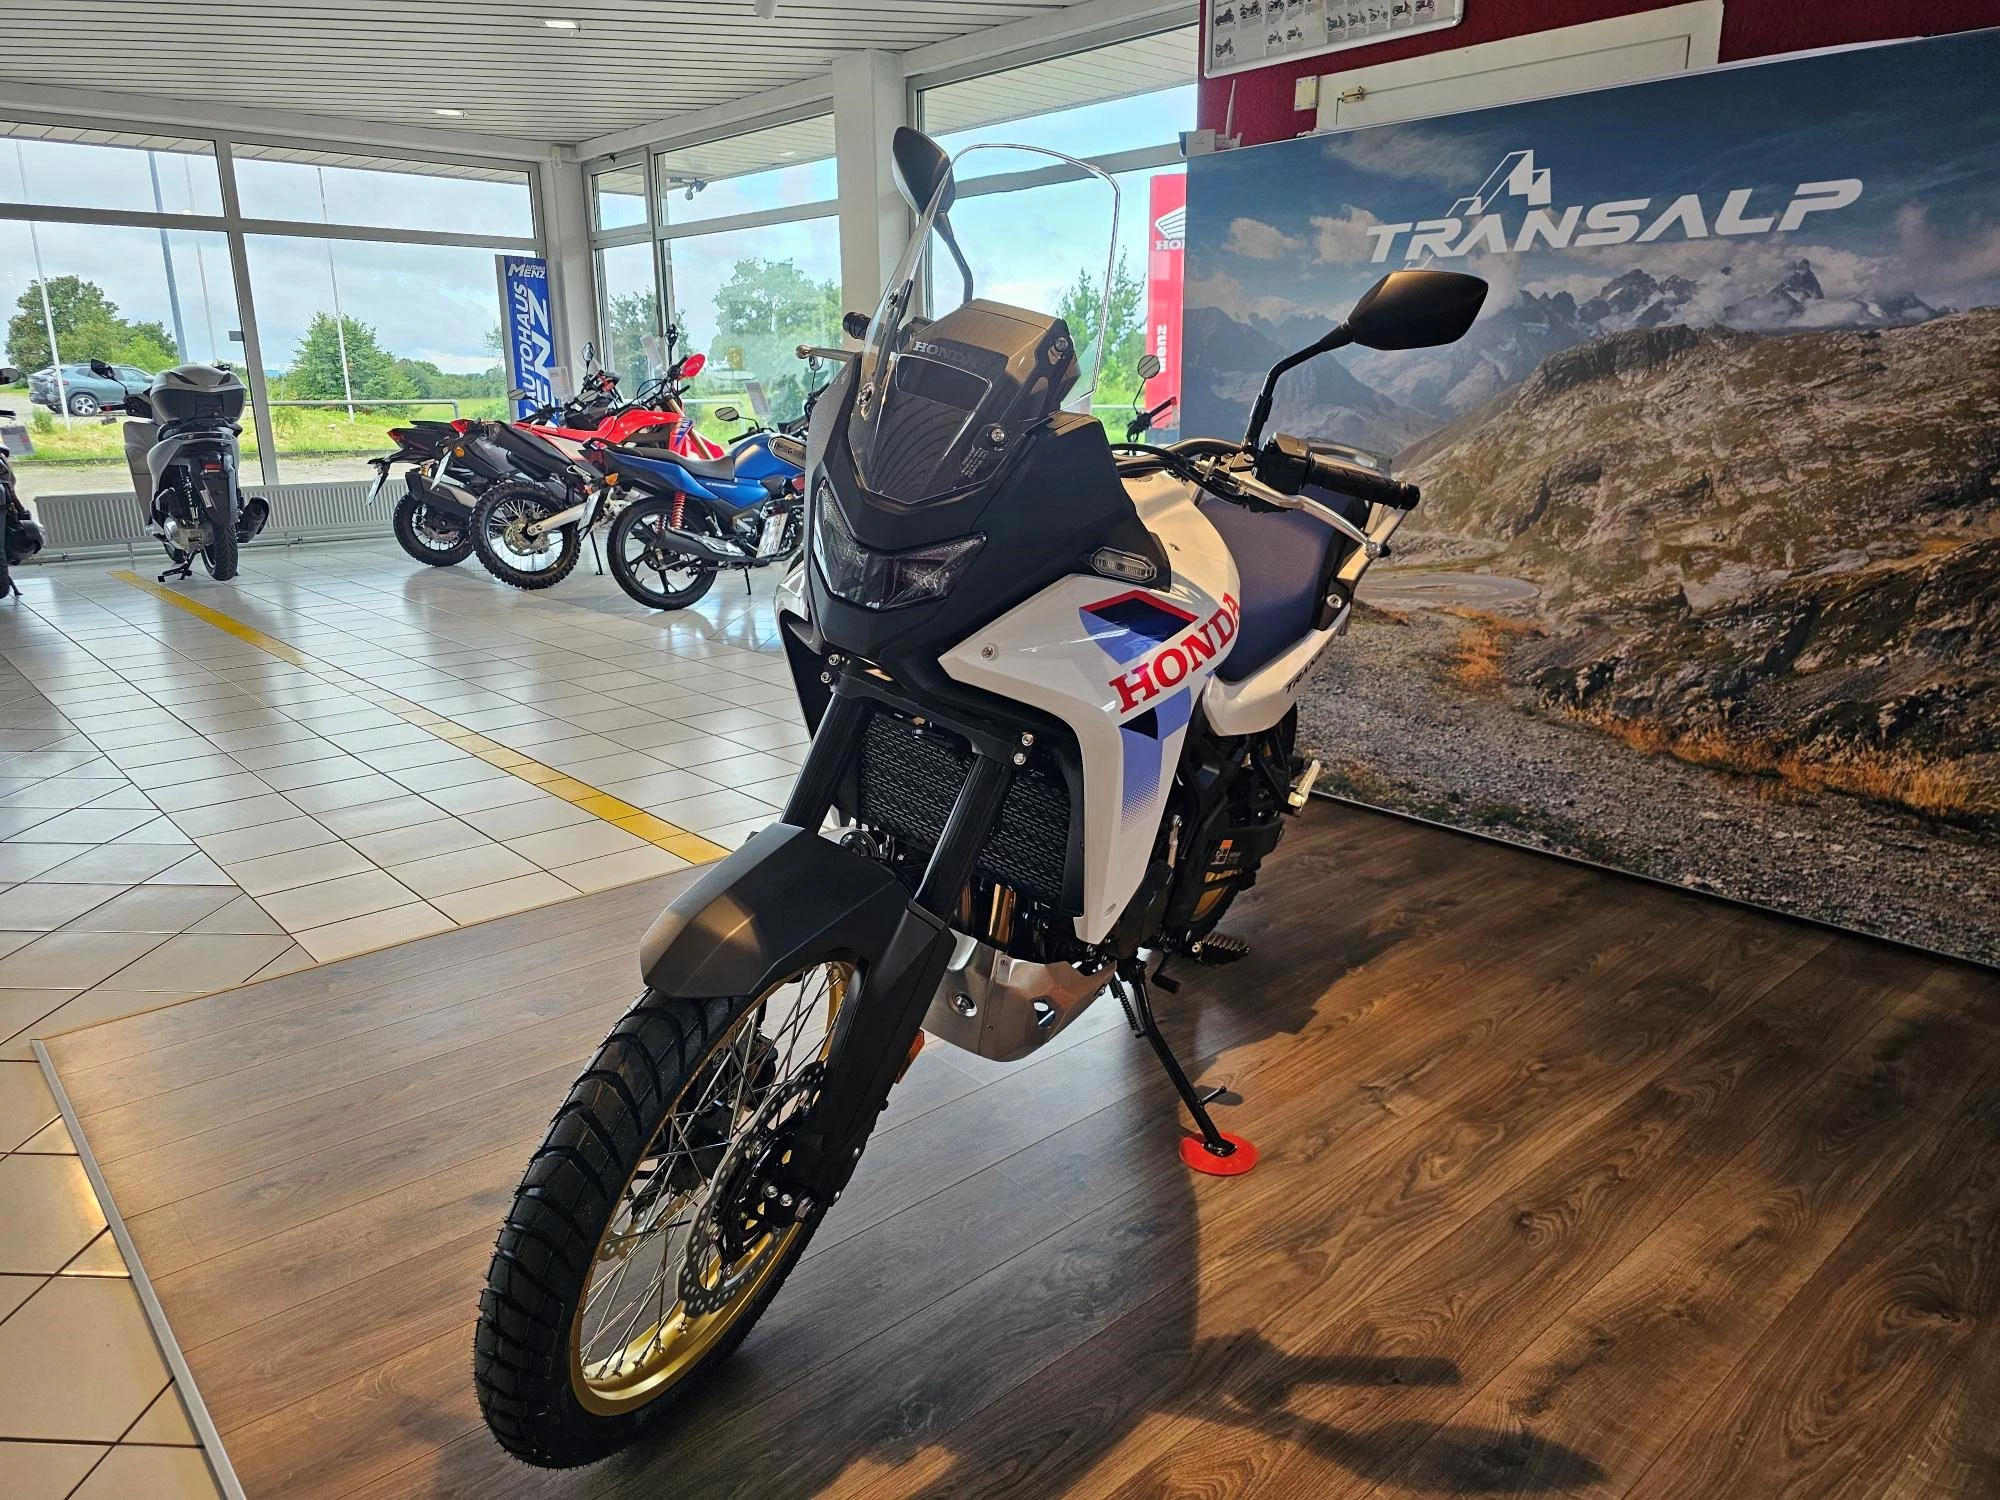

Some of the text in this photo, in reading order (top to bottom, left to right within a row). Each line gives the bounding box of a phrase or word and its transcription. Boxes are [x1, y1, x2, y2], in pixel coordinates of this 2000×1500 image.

[508, 263, 545, 278] MENZ
[1366, 178, 1864, 263] TRANSALP
[513, 281, 538, 407] AUTOHAUS
[1109, 592, 1239, 714] HONDA
